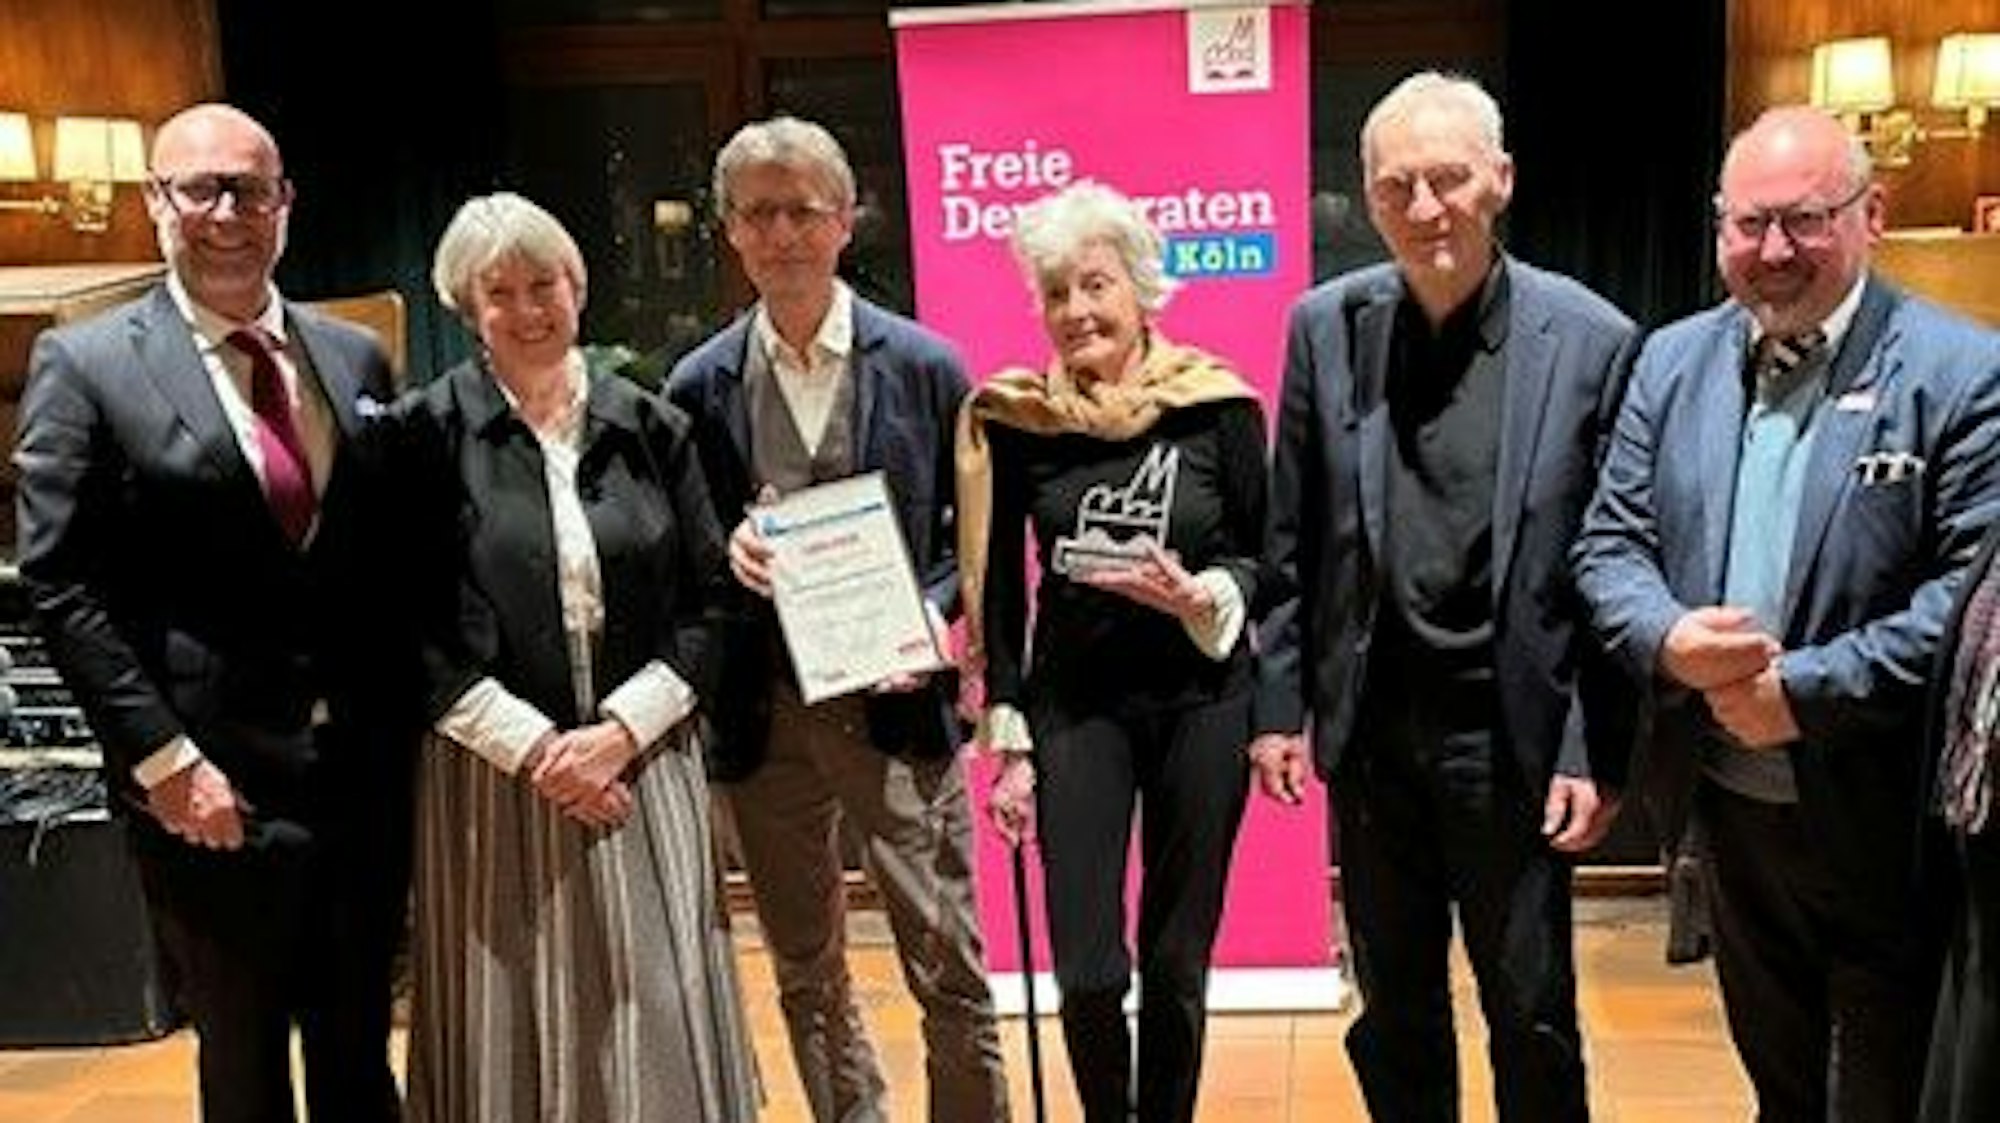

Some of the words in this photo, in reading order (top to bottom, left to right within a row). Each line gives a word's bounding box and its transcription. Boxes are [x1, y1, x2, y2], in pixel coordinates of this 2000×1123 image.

[939, 141, 1073, 190] Freie
[943, 189, 1275, 240] Deraten
[1174, 239, 1263, 273] Köln
